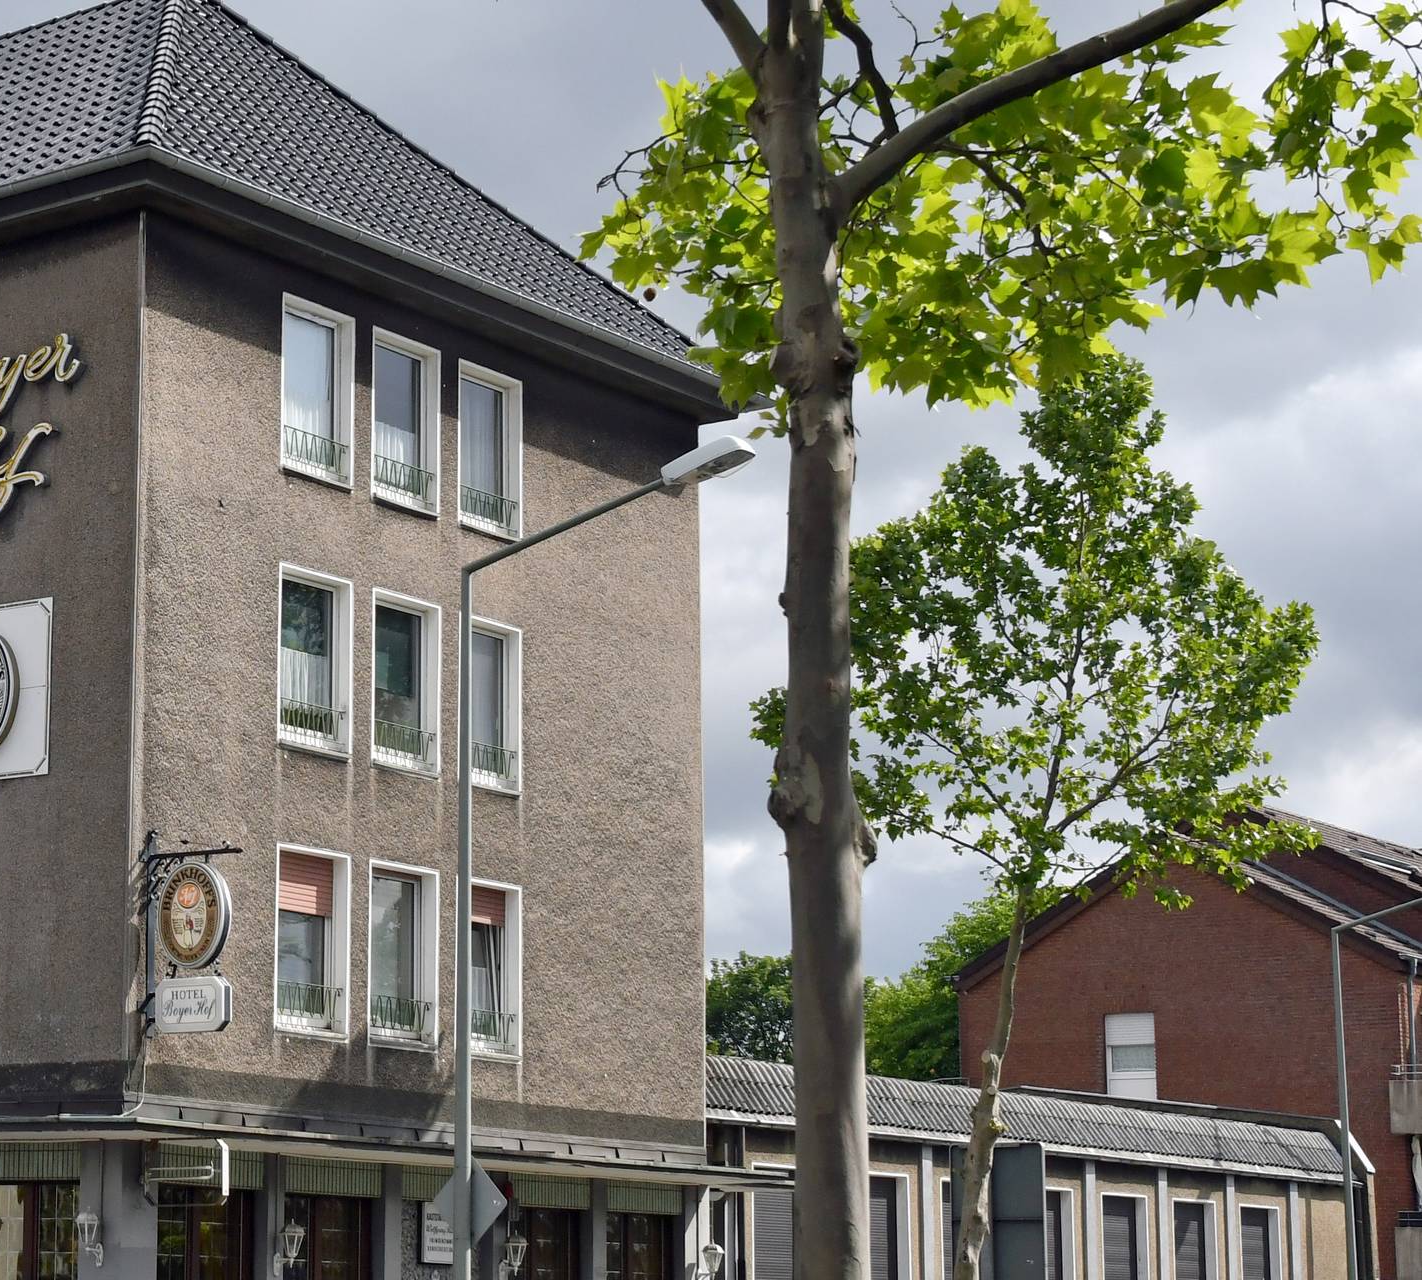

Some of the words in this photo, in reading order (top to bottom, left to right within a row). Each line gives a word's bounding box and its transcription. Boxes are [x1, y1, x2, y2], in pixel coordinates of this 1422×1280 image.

[163, 868, 217, 911] BRINKHOFF'S
[171, 989, 206, 1000] HOTEL
[162, 1000, 193, 1024] Boyer
[194, 999, 216, 1019] Hof
